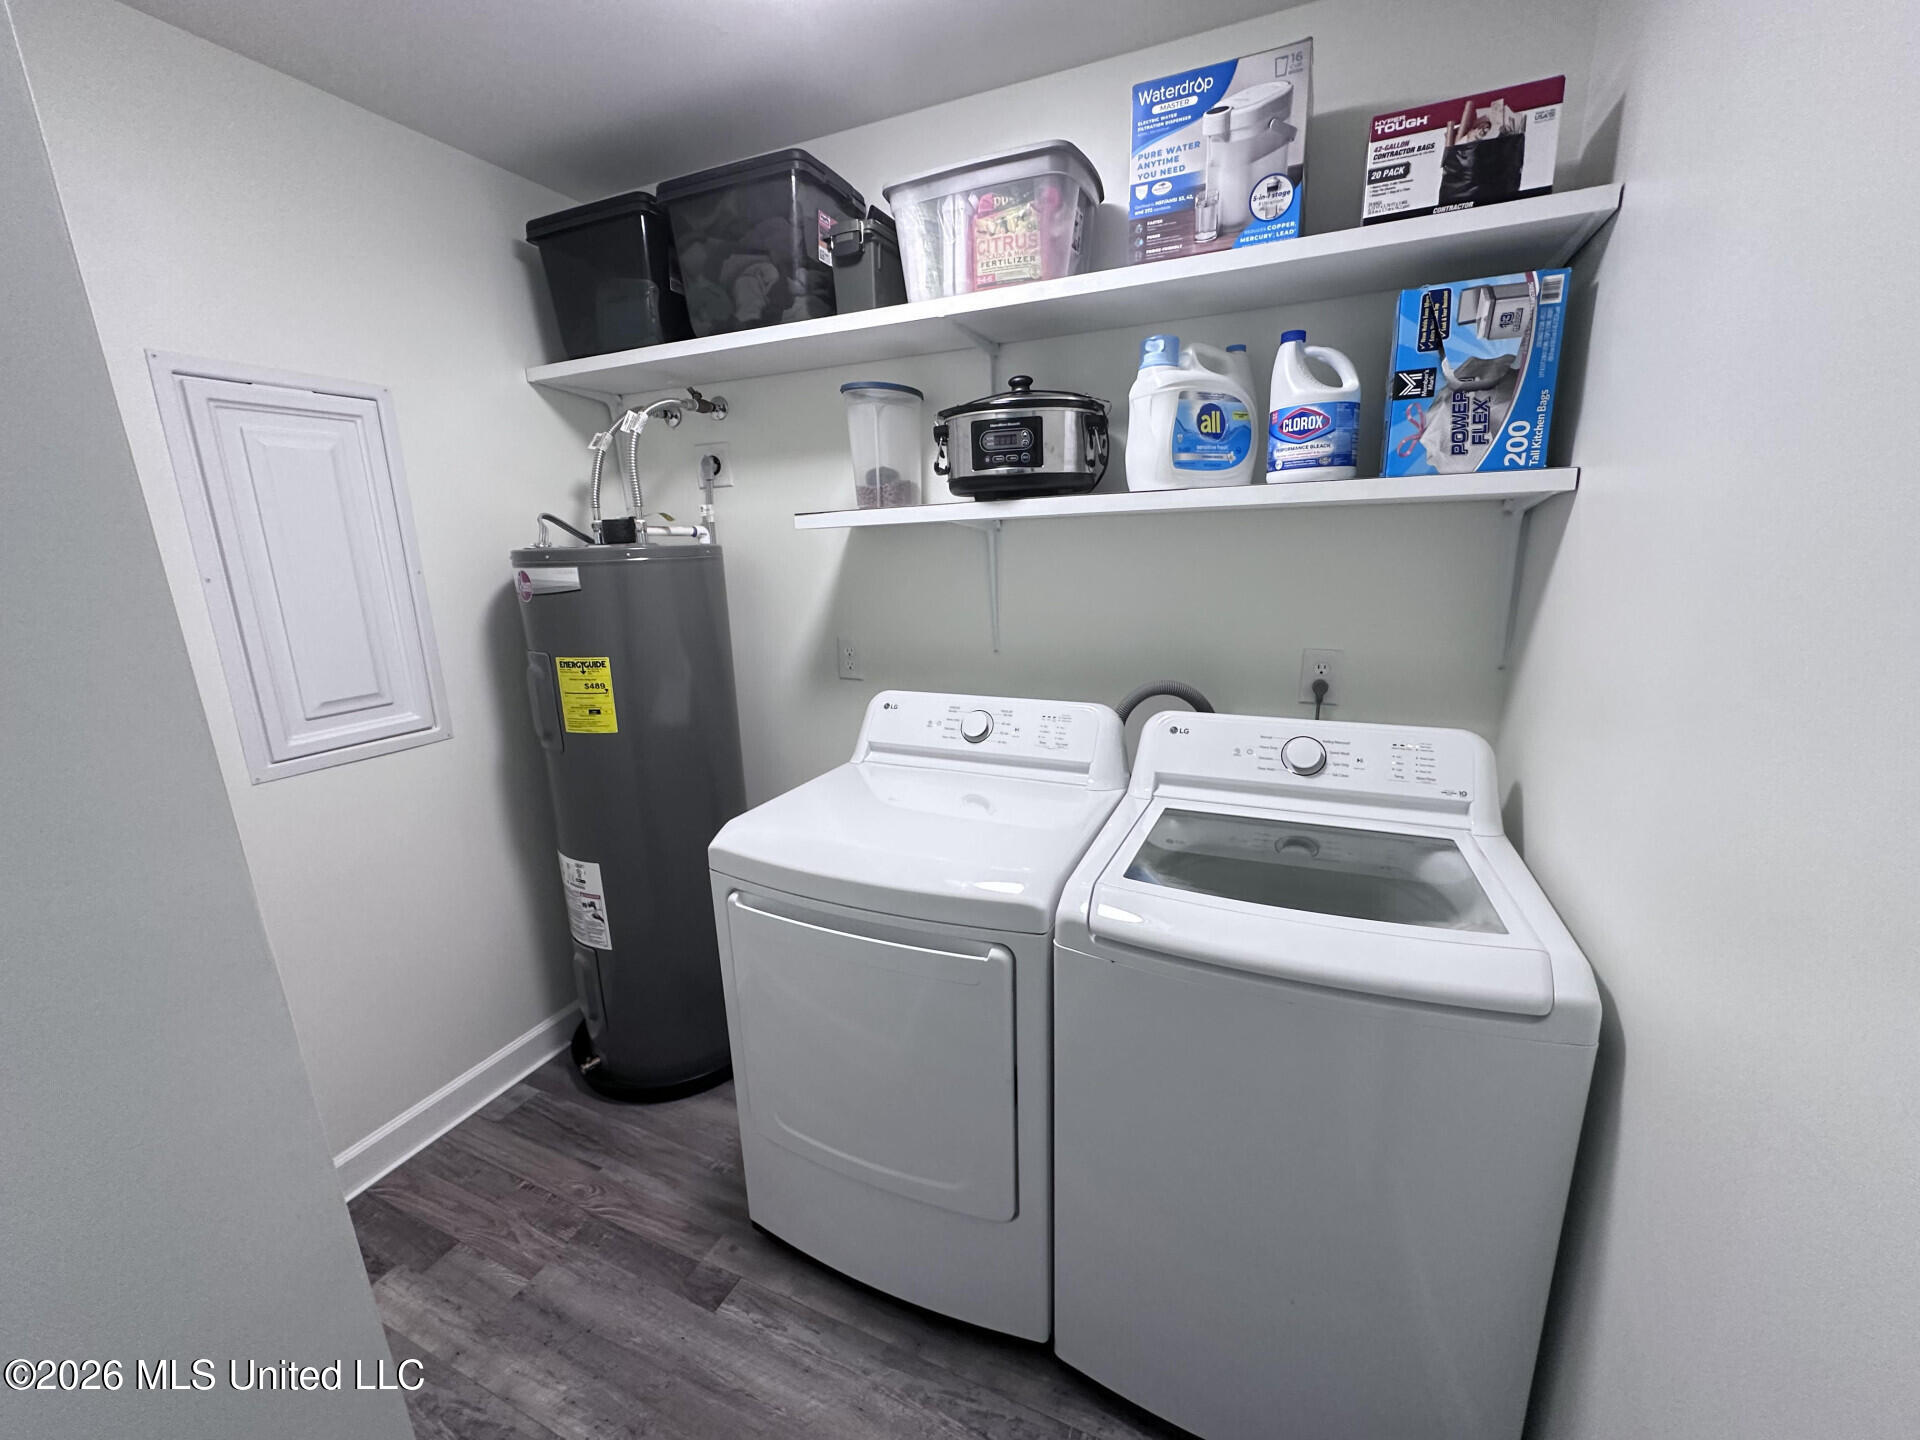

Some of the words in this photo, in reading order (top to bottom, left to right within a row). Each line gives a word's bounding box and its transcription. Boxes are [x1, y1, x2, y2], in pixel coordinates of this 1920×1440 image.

[1290, 51, 1303, 63] 16
[1138, 76, 1214, 106] Waterdrop
[1159, 99, 1190, 111] MASTER
[1375, 115, 1428, 135] TOUGH
[1137, 149, 1163, 161] PURE
[1165, 140, 1201, 155] WATER
[1373, 140, 1410, 153] 42-GALLON
[1373, 146, 1416, 161] CONTRACTOR
[1416, 142, 1436, 152] BAGS
[1137, 155, 1180, 170] ANYTIME
[1137, 170, 1157, 181] YOU
[1160, 164, 1186, 176] NEED
[1370, 171, 1381, 180] 20
[1382, 166, 1406, 178] PACK
[1271, 189, 1291, 199] stage
[1432, 201, 1475, 214] CONTRACTOR
[977, 231, 1038, 256] CITRUS
[981, 255, 1036, 268] FERTILIZER
[1500, 311, 1514, 328] 13
[1536, 389, 1551, 412] Bags
[1200, 410, 1222, 433] all
[1282, 415, 1323, 433] CLOROX
[1451, 391, 1469, 455] POWER
[1471, 396, 1491, 445] FLEX
[1531, 413, 1545, 449] Kitchen
[1503, 420, 1531, 466] 200
[1529, 450, 1540, 466] Tall
[584, 682, 606, 690] $489
